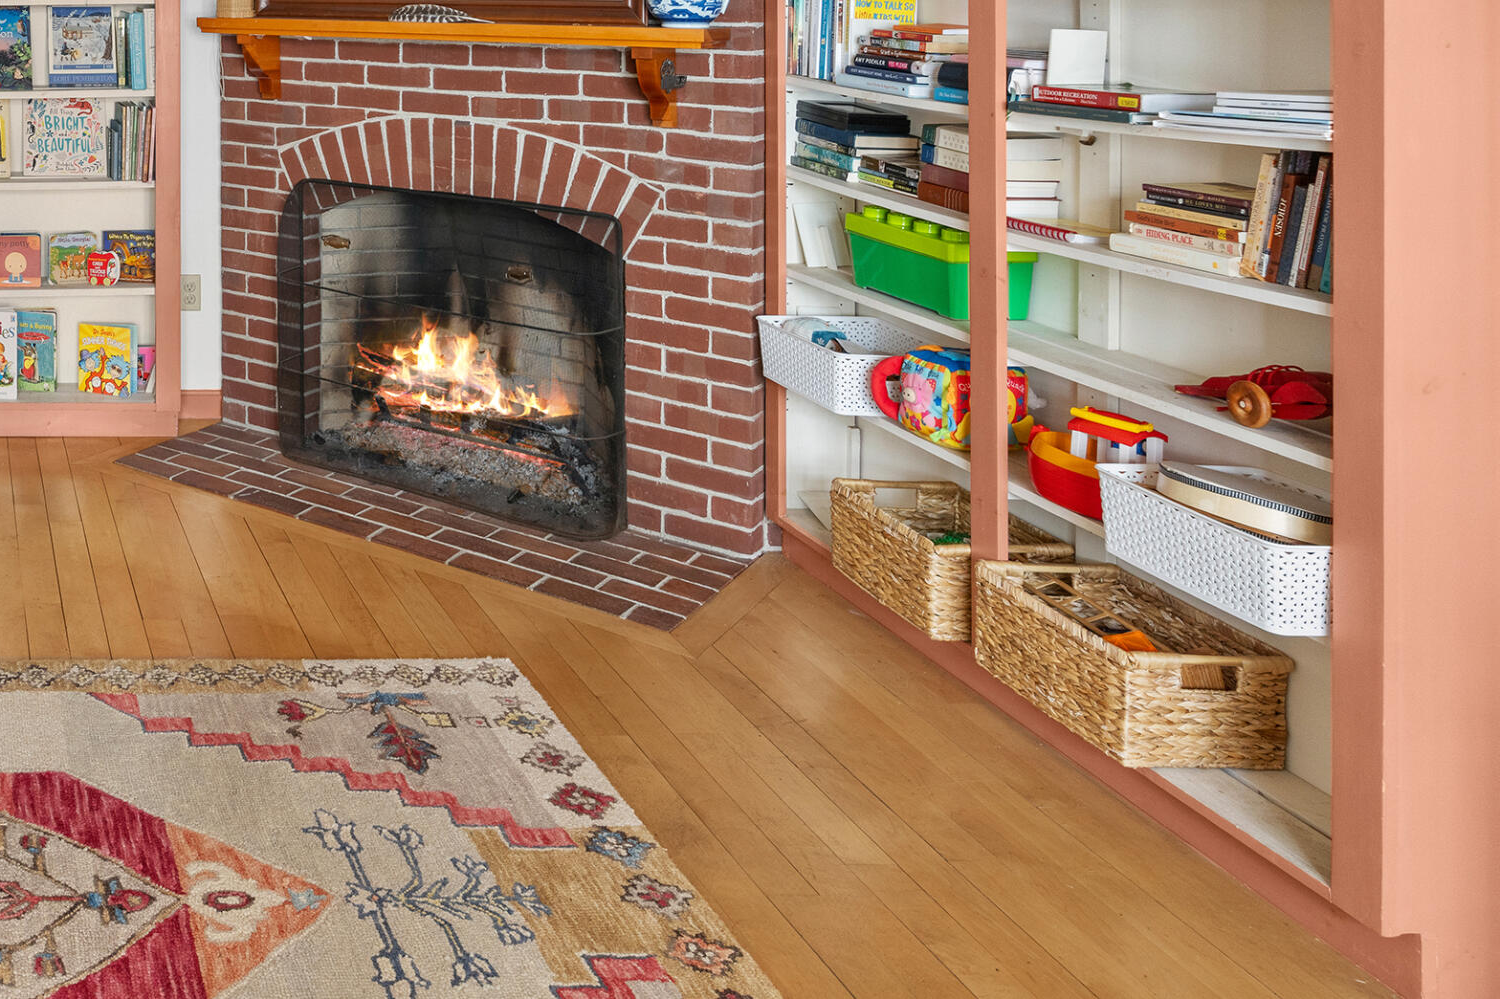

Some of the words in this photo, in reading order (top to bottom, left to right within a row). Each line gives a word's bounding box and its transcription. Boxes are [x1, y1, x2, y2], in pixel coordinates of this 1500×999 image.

[855, 0, 871, 8] HOW
[873, 0, 883, 8] TO
[884, 0, 902, 10] TALK
[904, 1, 915, 10] SO
[1062, 91, 1098, 100] RECREATION
[44, 115, 88, 131] BRIGHT
[37, 137, 91, 153] BEAUTIFUL
[1145, 228, 1170, 241] HIDING
[1172, 234, 1194, 246] PLACE
[9, 240, 30, 248] potty
[34, 323, 52, 331] Bunny
